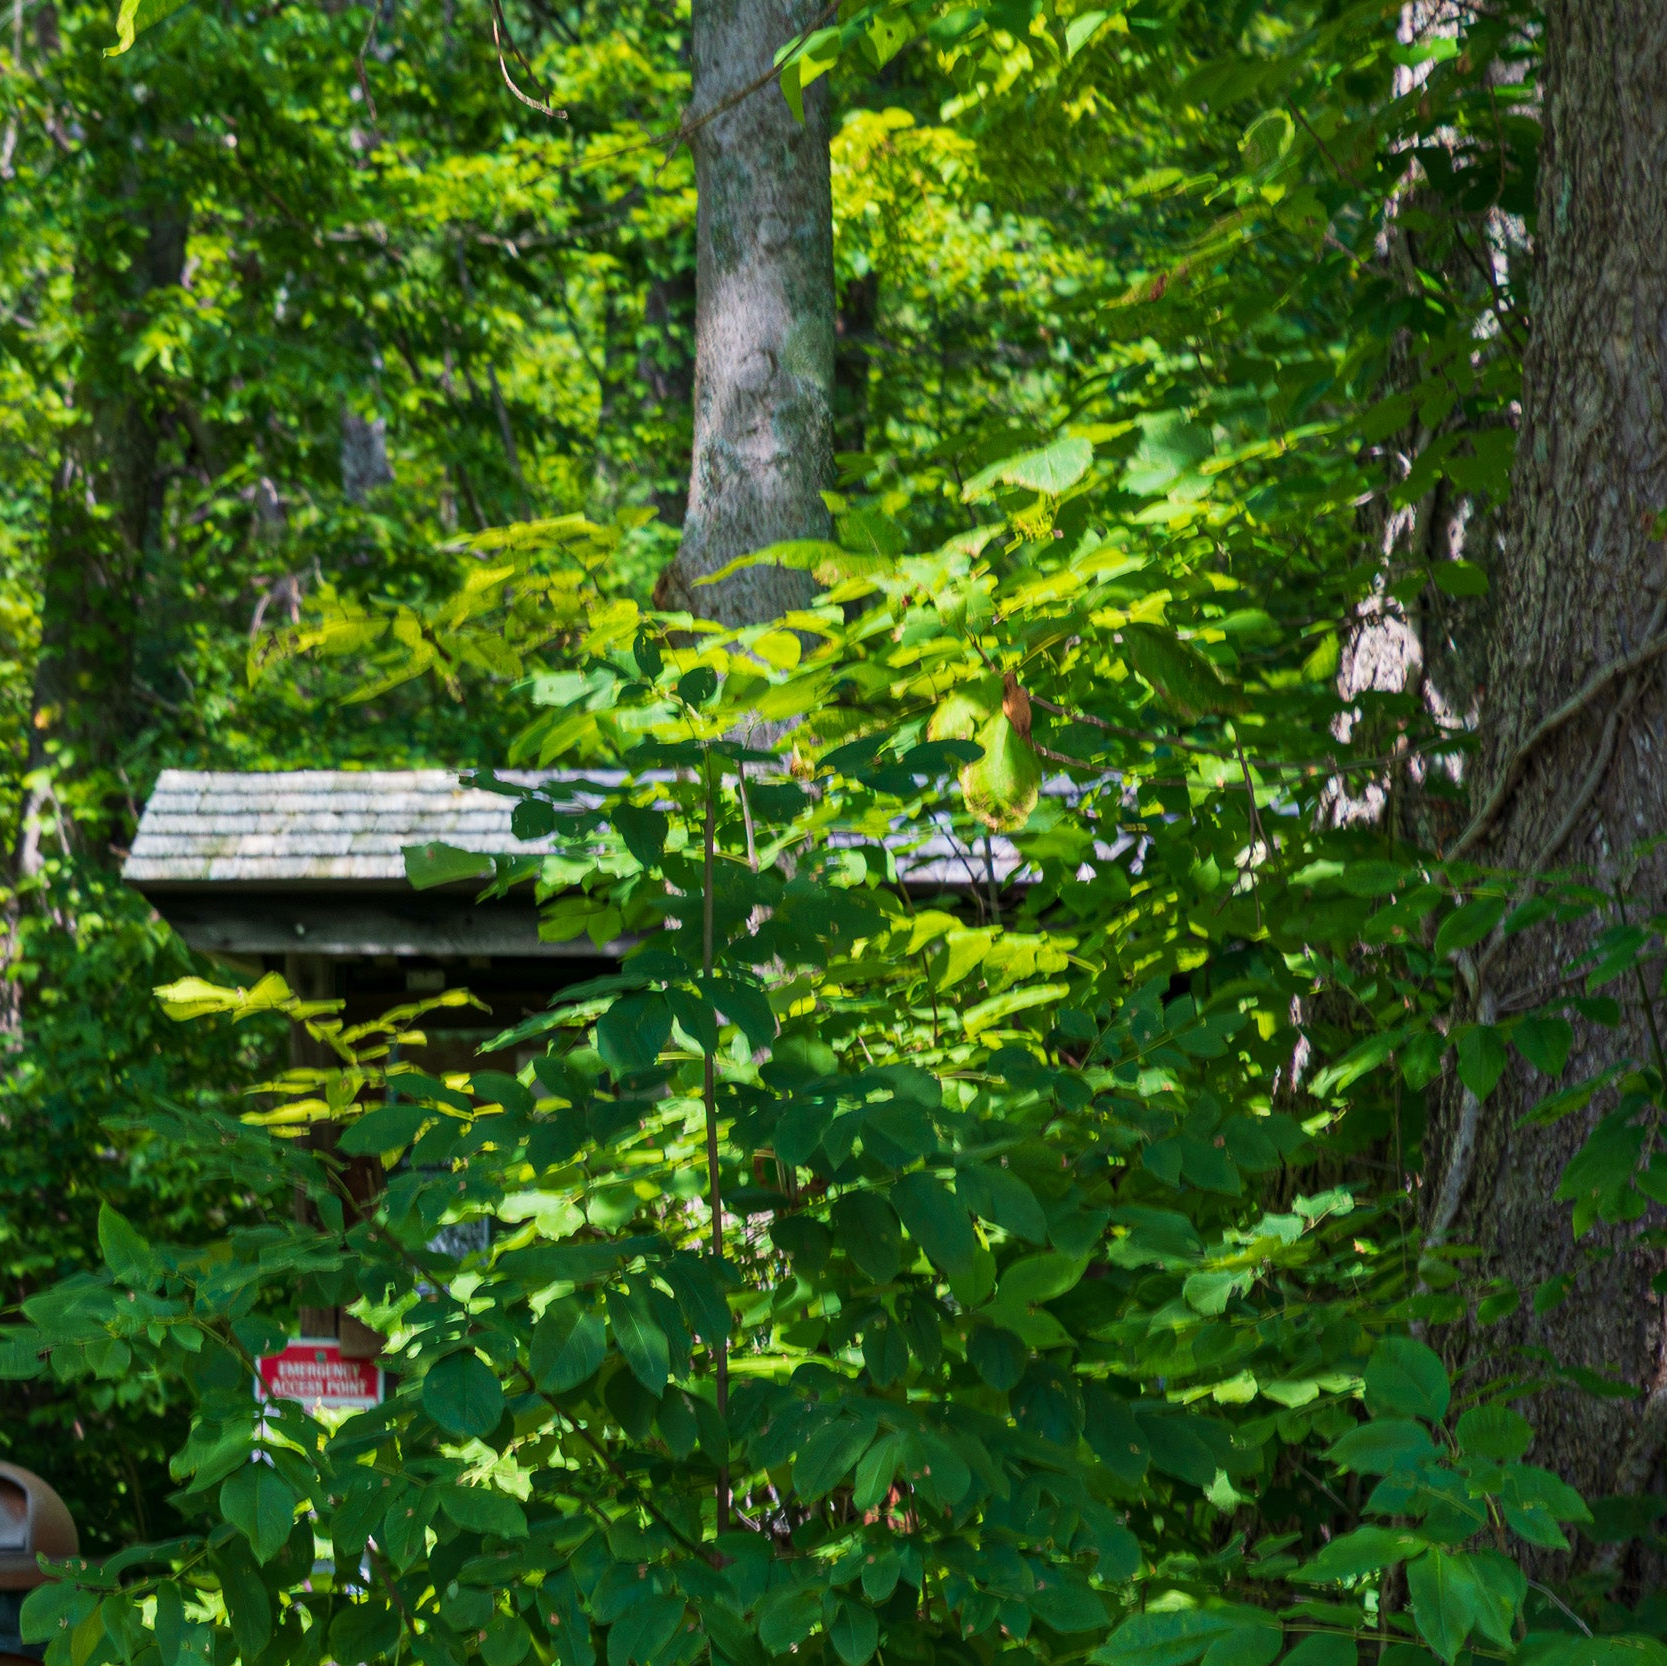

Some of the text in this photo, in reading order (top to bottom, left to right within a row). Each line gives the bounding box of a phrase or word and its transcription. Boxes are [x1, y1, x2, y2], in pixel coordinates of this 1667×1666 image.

[277, 1361, 361, 1377] EMERGENCY
[272, 1377, 366, 1395] ACCESS POINT
